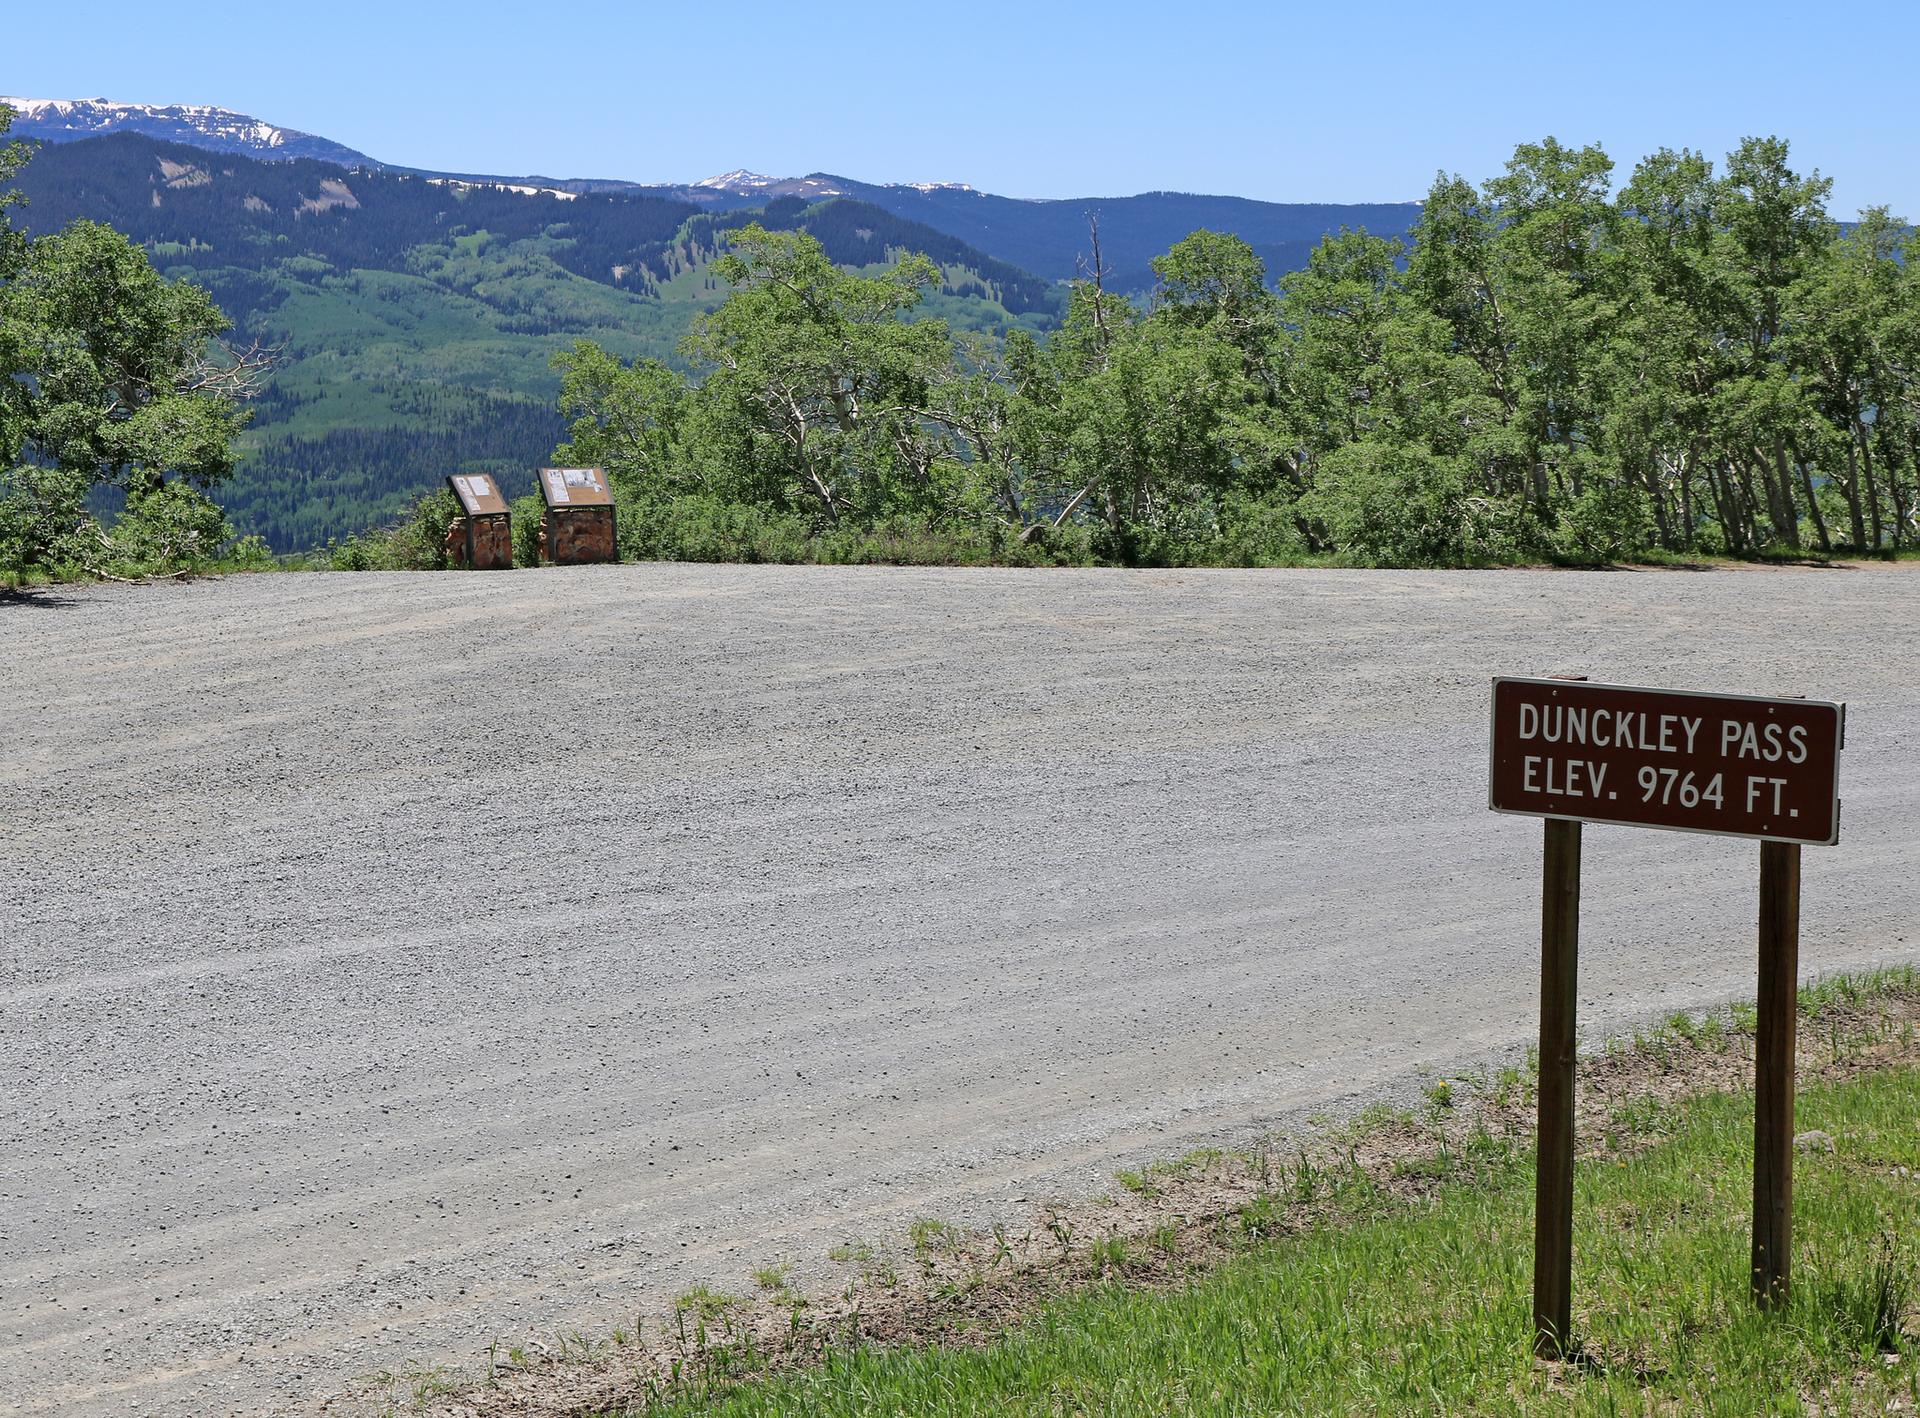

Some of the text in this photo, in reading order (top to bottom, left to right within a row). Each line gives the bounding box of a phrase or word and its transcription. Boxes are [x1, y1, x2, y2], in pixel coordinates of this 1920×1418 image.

[1519, 703, 1807, 764] DUNCKLEY PASS
[1524, 755, 1798, 817] ELEV. 9764 FT.
